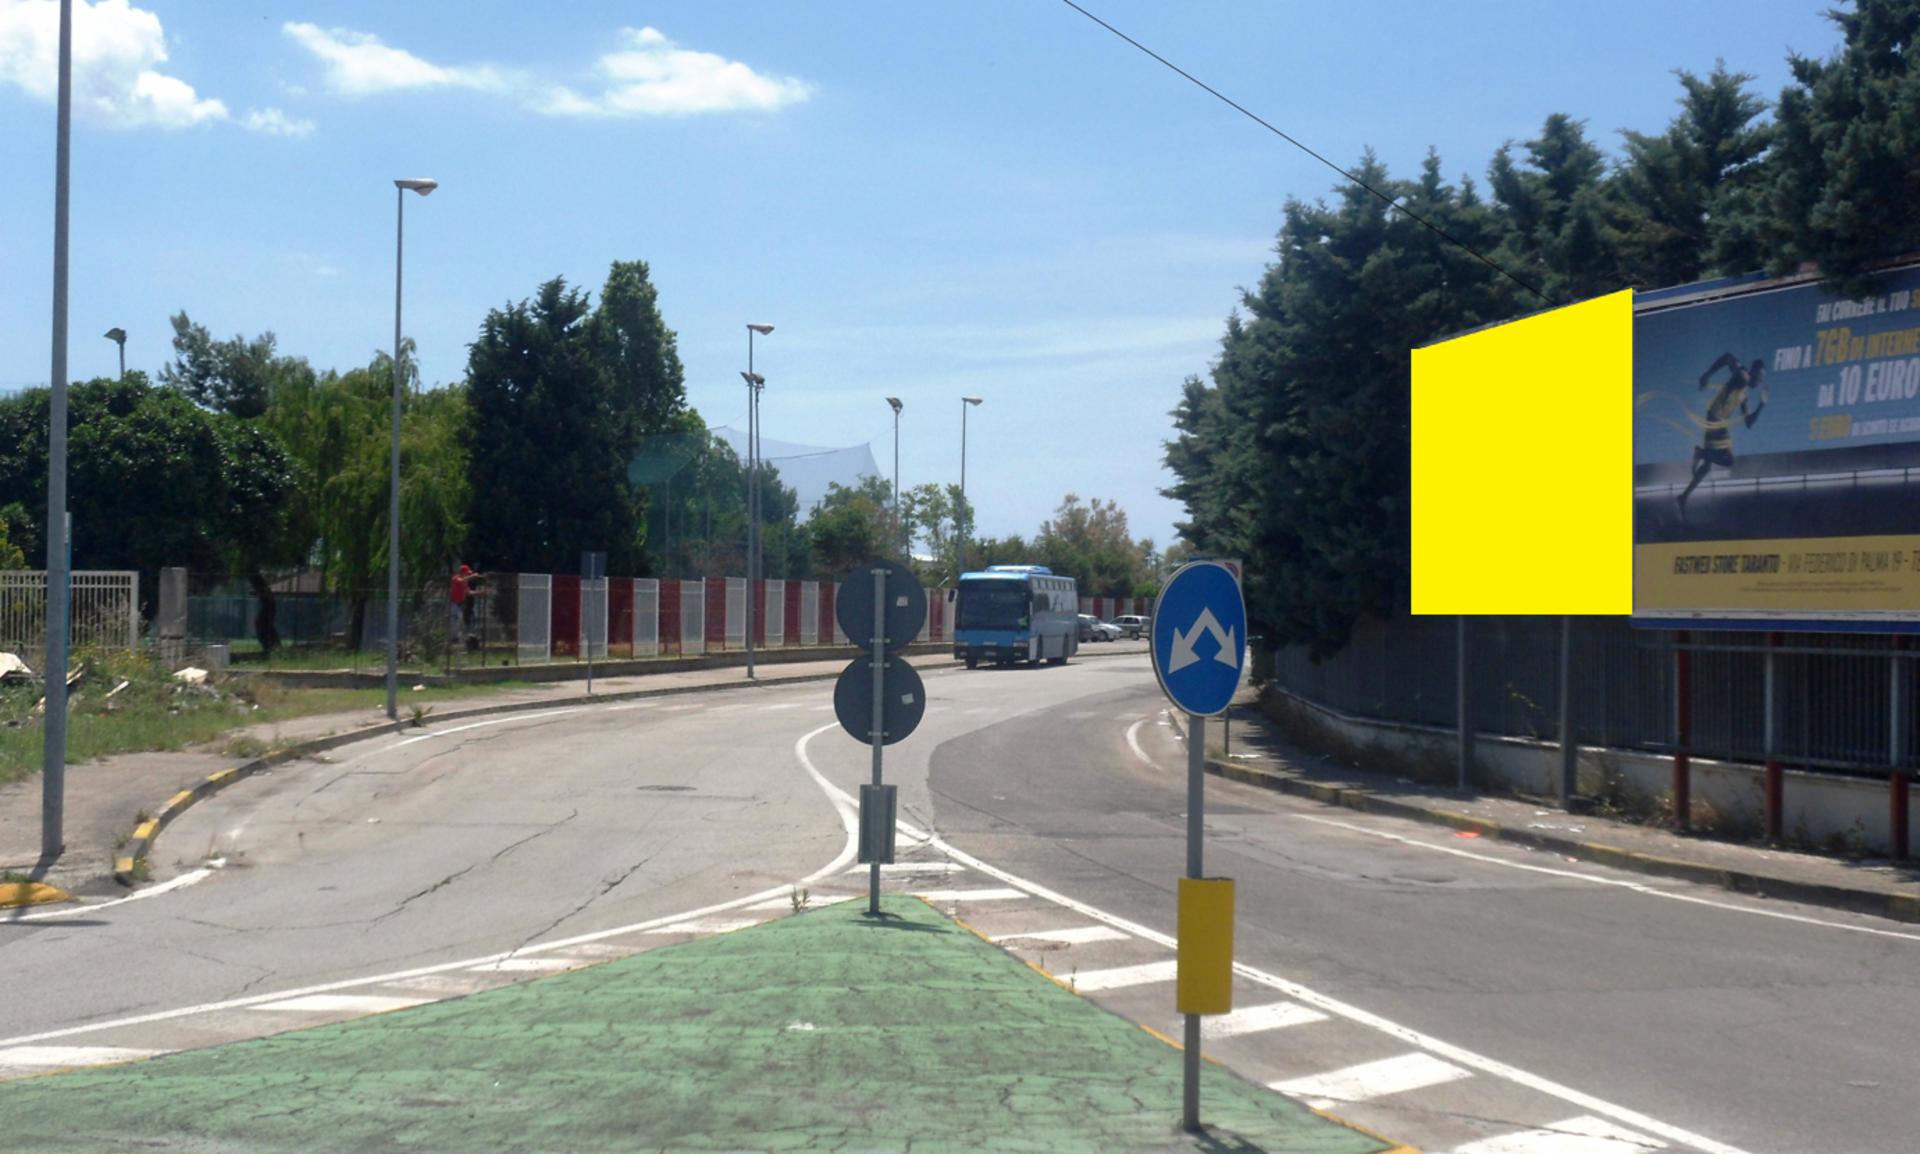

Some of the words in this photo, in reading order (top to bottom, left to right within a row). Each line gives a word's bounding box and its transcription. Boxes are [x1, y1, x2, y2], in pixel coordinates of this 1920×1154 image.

[1889, 290, 1910, 312] TUO
[1773, 346, 1801, 371] FINO
[1802, 345, 1812, 368] A
[1815, 327, 1851, 367] 7GB
[1837, 365, 1860, 406] 10
[1864, 357, 1920, 403] EURO
